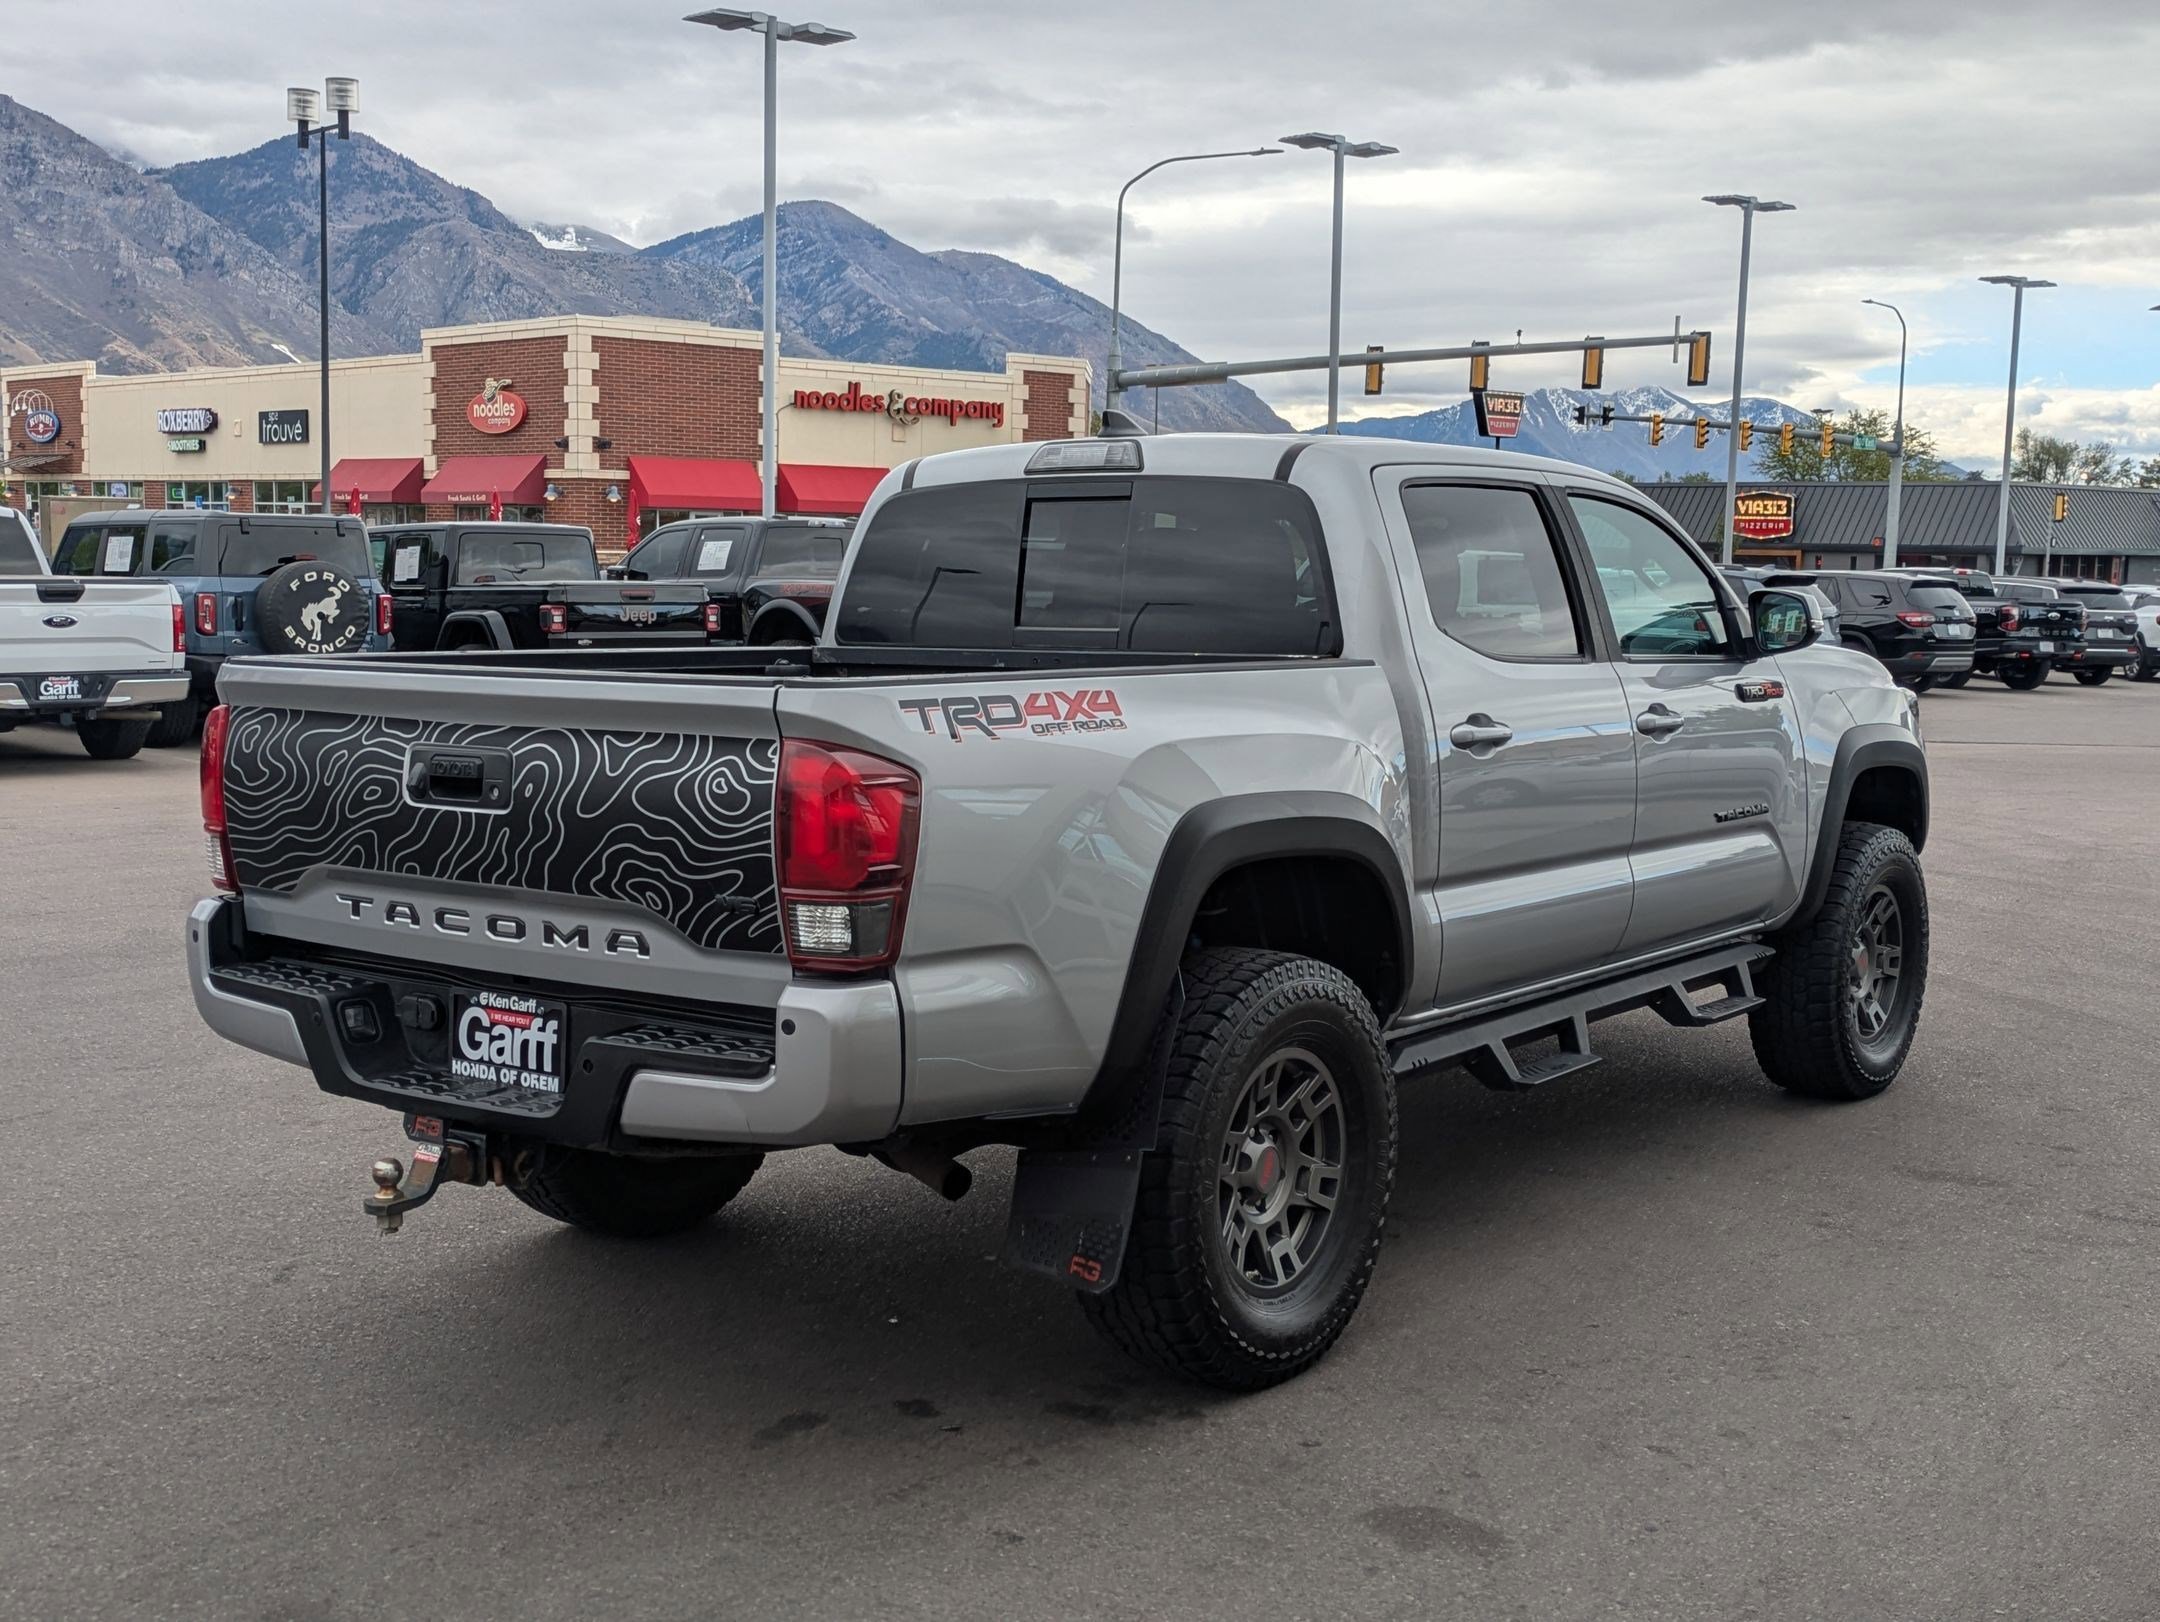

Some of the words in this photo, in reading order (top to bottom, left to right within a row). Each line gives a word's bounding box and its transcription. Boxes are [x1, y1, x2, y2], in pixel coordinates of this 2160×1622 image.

[473, 395, 516, 418] noodles
[794, 381, 885, 413] noodles
[887, 389, 920, 425] &
[904, 396, 1004, 428] company
[29, 414, 53, 427] RUMBI
[158, 410, 206, 432] ROXBERRY
[268, 412, 279, 423] spa
[167, 440, 199, 451] SMOOTHIES
[290, 571, 350, 592] FORD
[620, 607, 657, 624] Jeep
[284, 625, 356, 653] BRONCO
[40, 680, 79, 696] Garff
[898, 695, 1027, 743] TRD
[1031, 722, 1069, 737] OFF
[1072, 717, 1127, 734] ROAD
[431, 760, 476, 776] TOYOTA
[1718, 803, 1769, 821] TACOMA
[336, 892, 650, 960] TACOMA
[502, 1014, 516, 1023] HEAR
[515, 1016, 527, 1025] YOU
[458, 1006, 558, 1072] Garff
[452, 1060, 497, 1081] HONDA
[500, 1068, 518, 1084] OF
[520, 1072, 559, 1093] OREM
